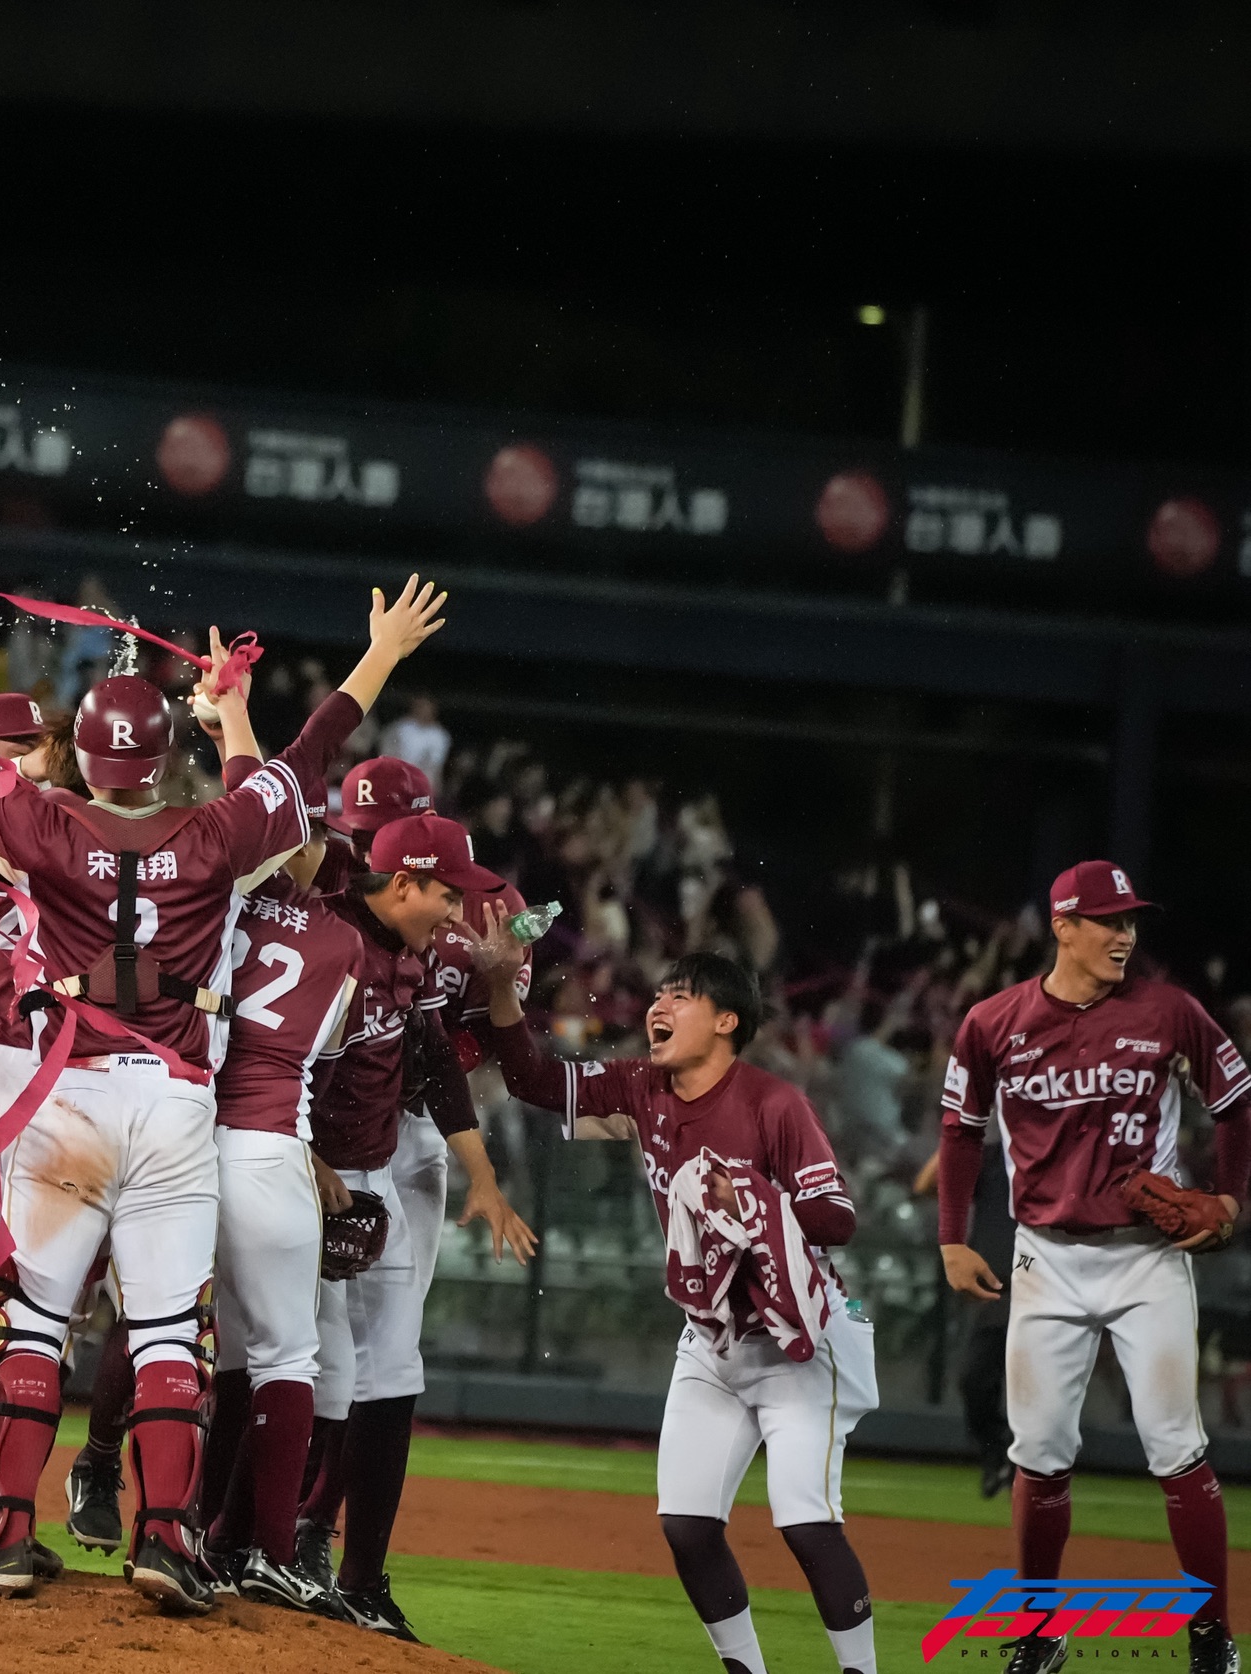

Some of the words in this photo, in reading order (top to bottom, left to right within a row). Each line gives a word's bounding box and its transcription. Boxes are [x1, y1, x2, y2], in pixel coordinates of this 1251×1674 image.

[29, 701, 44, 725] R
[109, 720, 141, 750] R
[355, 779, 378, 806] R
[305, 802, 327, 817] igerair
[403, 853, 439, 868] tigerair
[1111, 869, 1132, 894] R
[1108, 1112, 1146, 1146] 36
